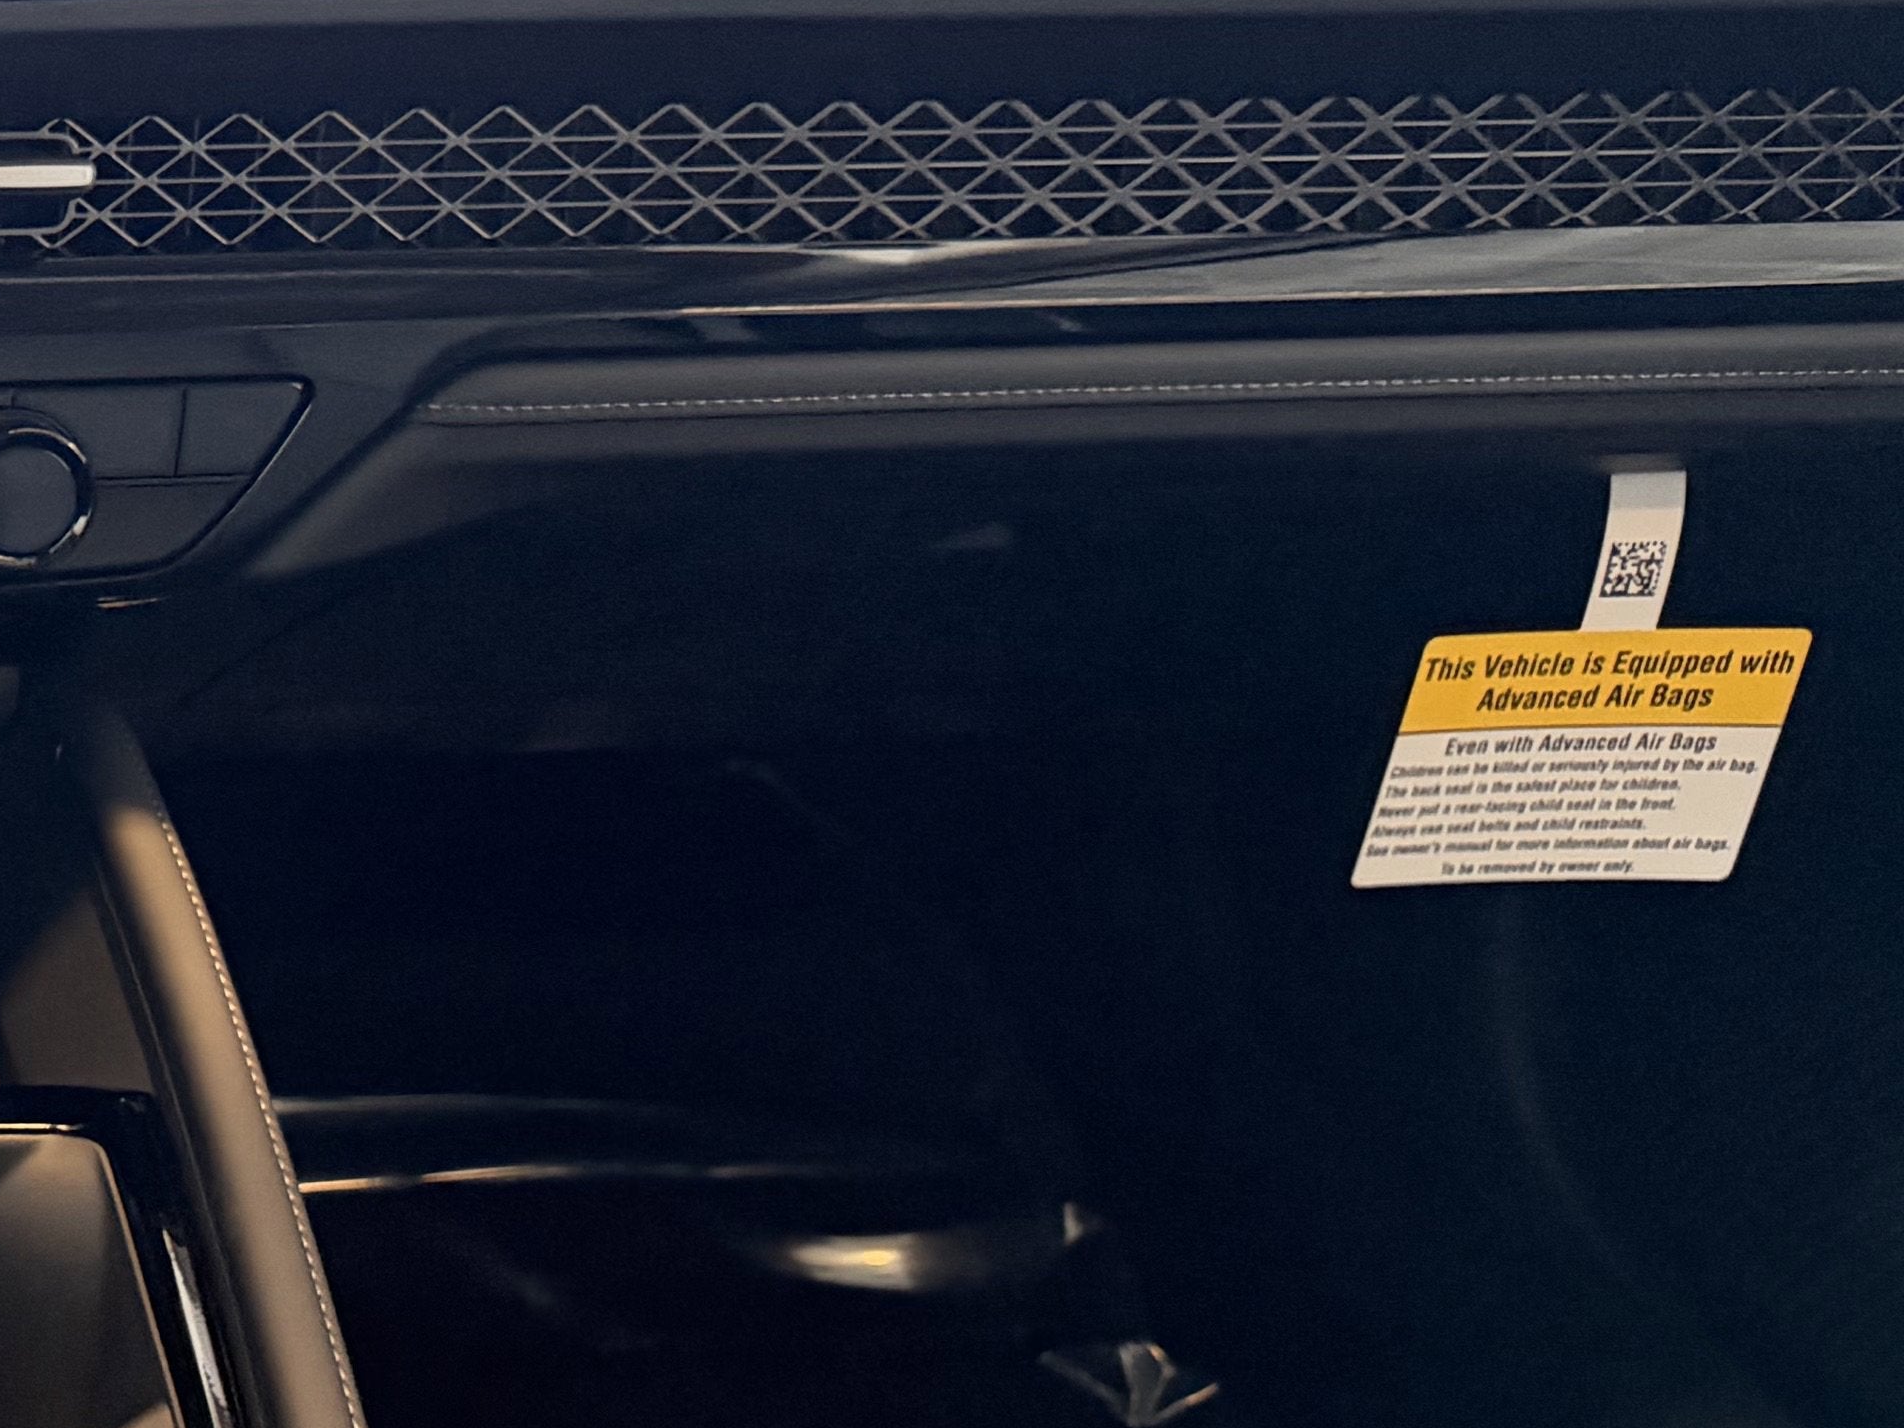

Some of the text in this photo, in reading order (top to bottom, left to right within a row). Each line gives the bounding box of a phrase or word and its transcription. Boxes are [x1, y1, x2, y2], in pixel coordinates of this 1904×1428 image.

[1425, 649, 1795, 682] This Vehicle is Equipped with
[1476, 682, 1715, 712] Advanced Air Bags
[1445, 732, 1718, 756] Even with Advanced Air Bags
